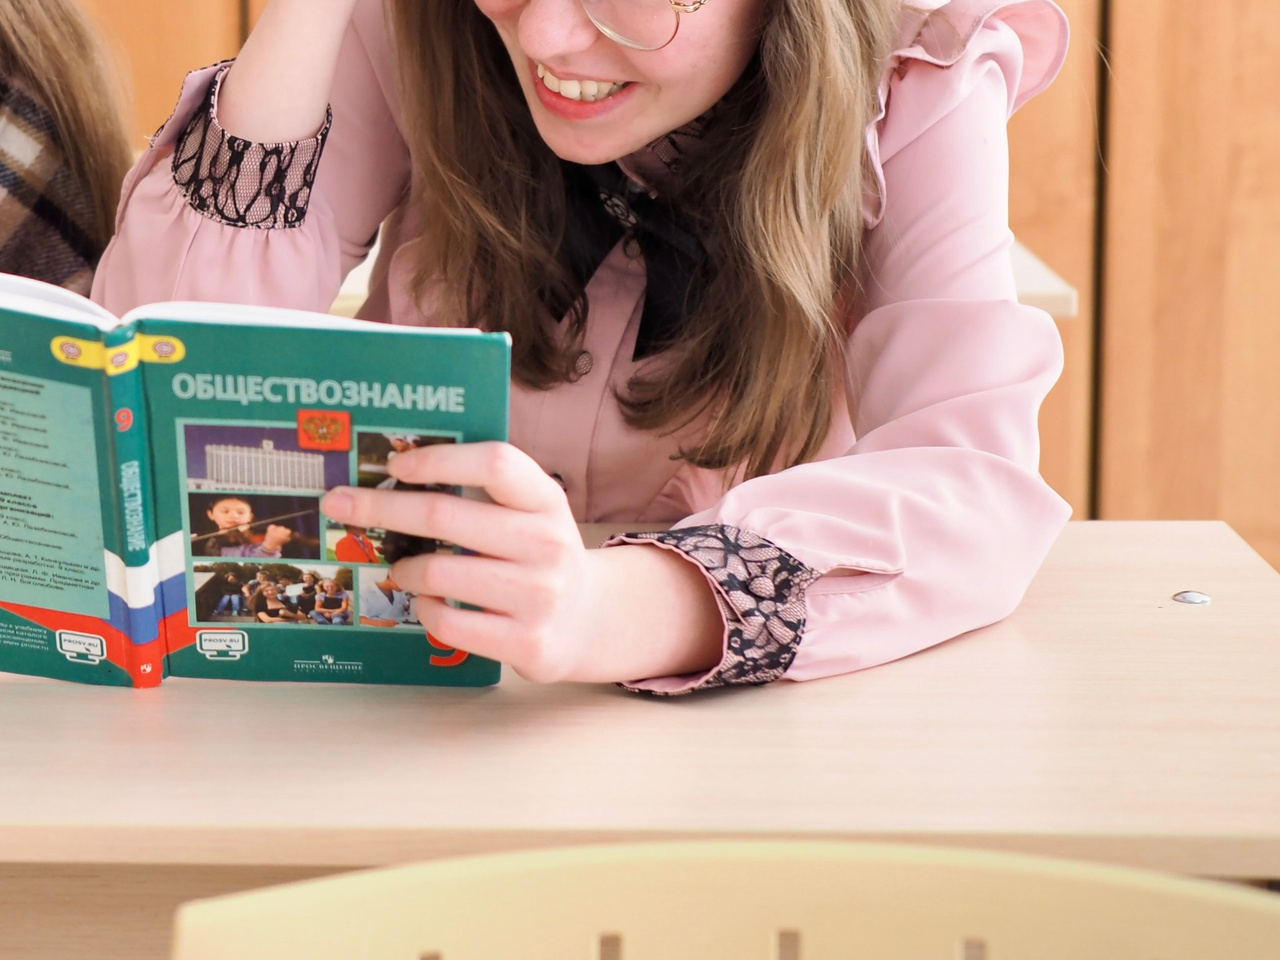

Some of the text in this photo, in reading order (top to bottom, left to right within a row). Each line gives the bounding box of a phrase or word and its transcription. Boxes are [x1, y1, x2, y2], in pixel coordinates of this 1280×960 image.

[172, 373, 465, 413] ОБЩЕСТВОЗНАНИЕ
[114, 407, 133, 432] 9
[120, 460, 146, 552] ОБЩЕСТВОЗНАНИЕ
